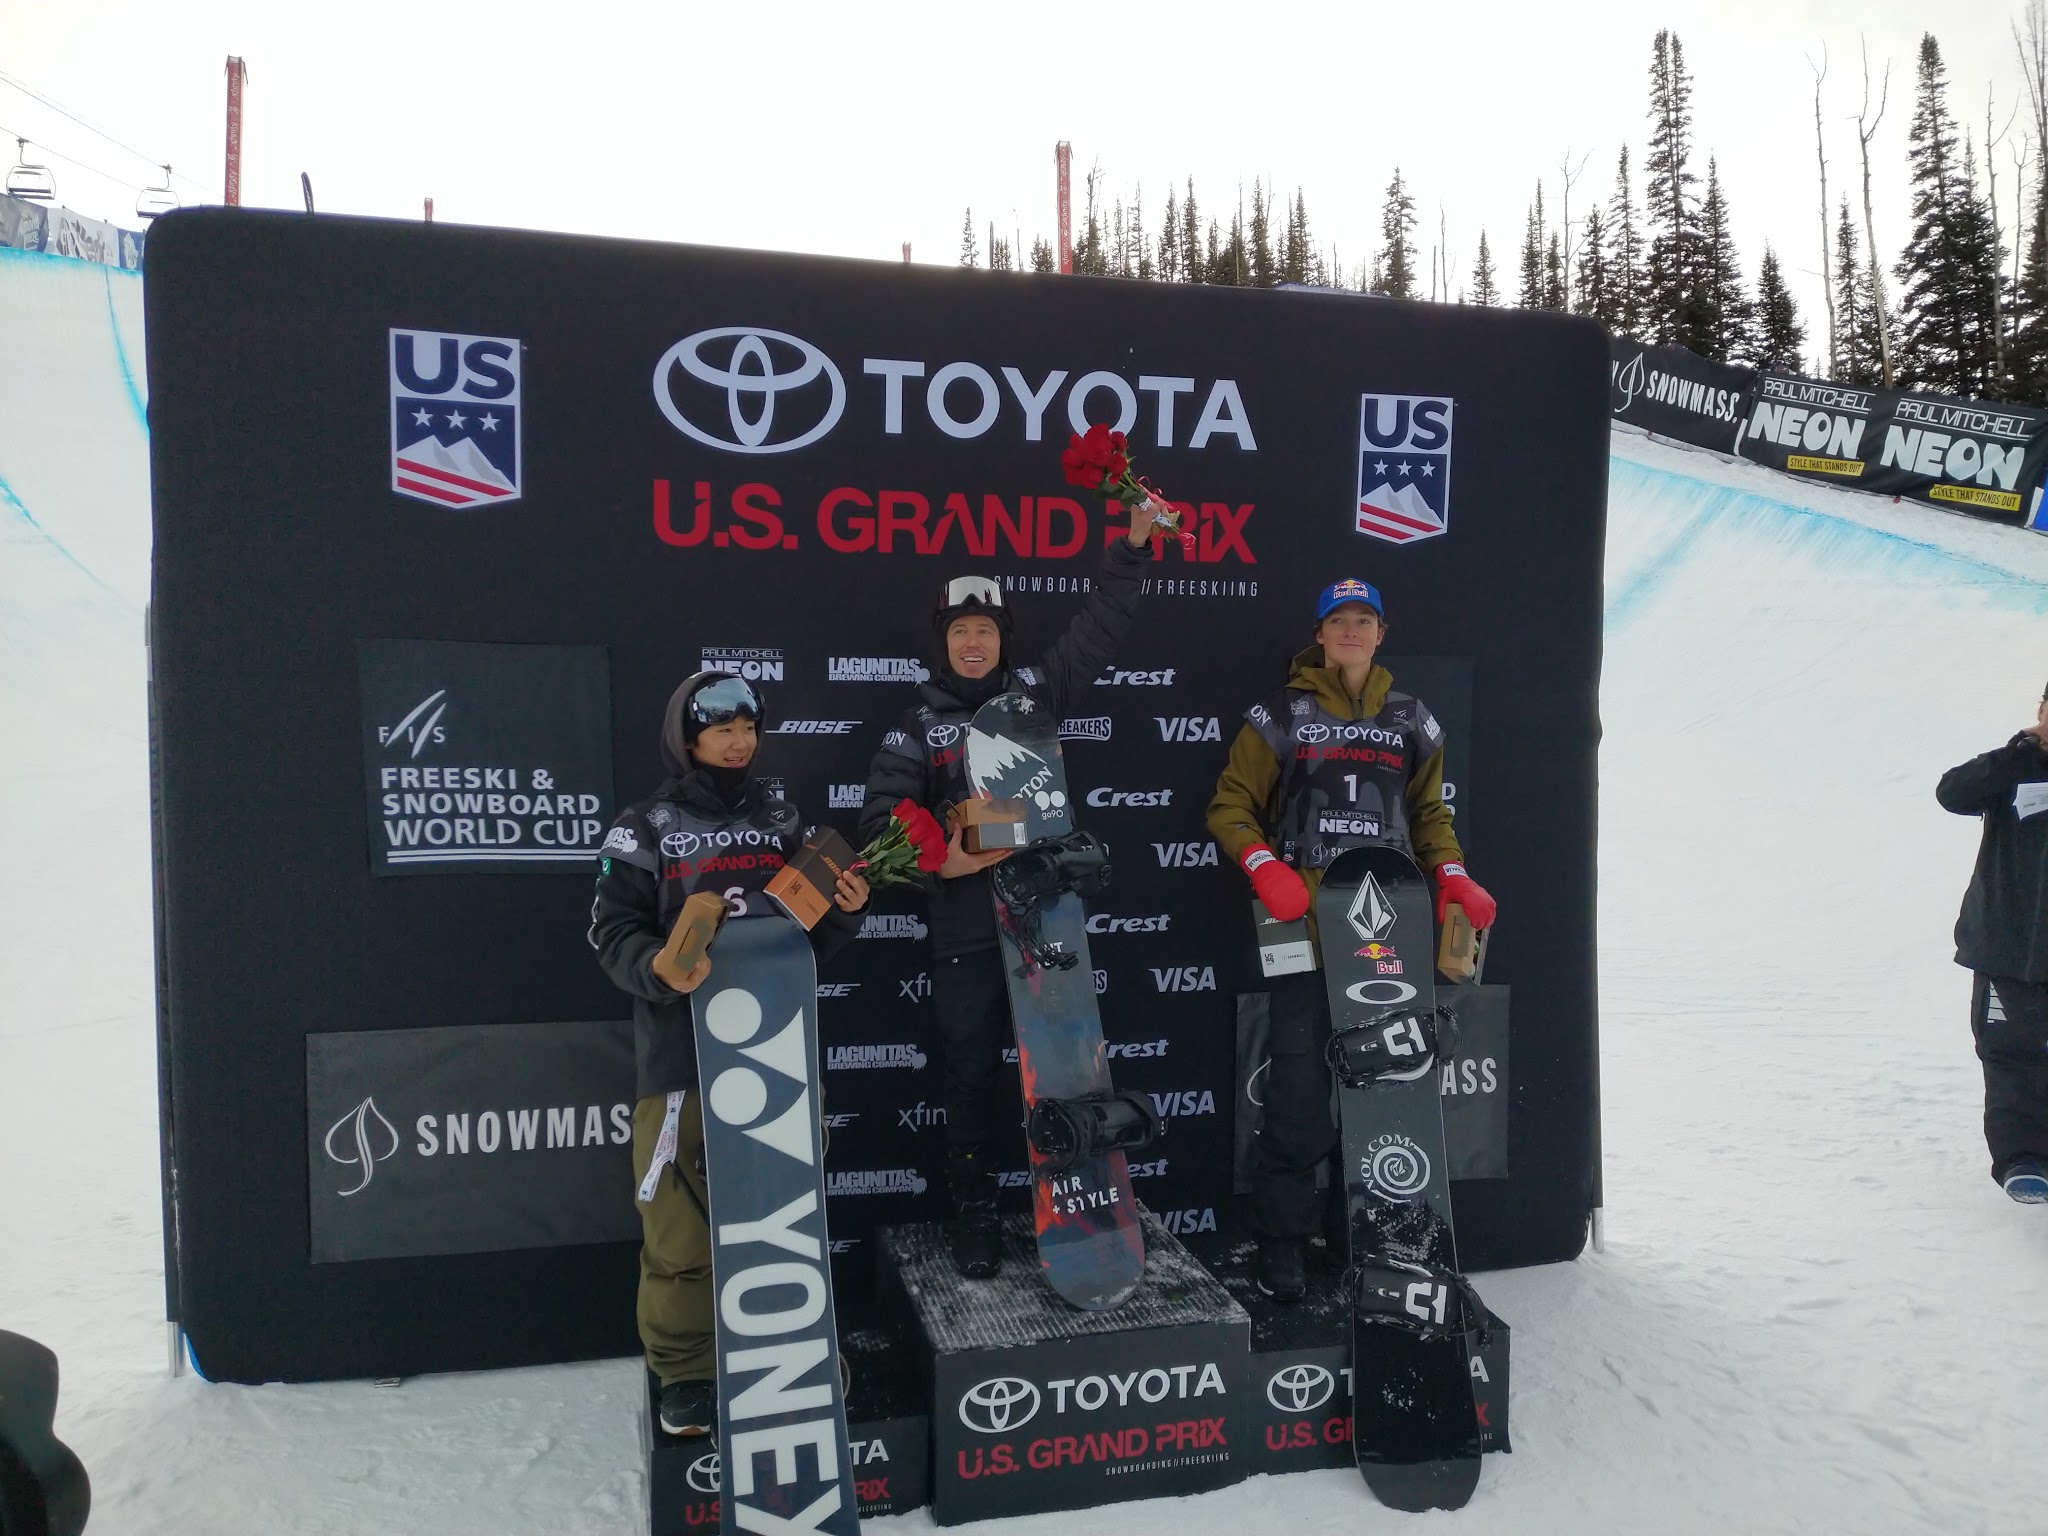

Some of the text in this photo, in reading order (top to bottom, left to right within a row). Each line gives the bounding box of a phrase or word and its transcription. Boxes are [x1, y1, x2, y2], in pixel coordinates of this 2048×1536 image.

[395, 334, 515, 400] US
[863, 358, 1258, 451] TOYOTA
[1764, 379, 1870, 411] PAUL MITCHELL
[1363, 398, 1449, 451] US
[1896, 401, 2031, 437] PAUL MITCHELL
[1748, 402, 1866, 459] NEON
[1790, 457, 1862, 473] STYLE THAT STANDS OUT
[1880, 424, 2025, 491] NEON
[1932, 486, 2018, 507] STYLE THAT STANDS OUT
[653, 480, 798, 550] U.S.
[816, 487, 1088, 559] GRAND
[994, 575, 1092, 594] SNOWBOAR
[1333, 589, 1369, 599] Red Bull
[702, 648, 783, 658] PAUL MITCHELL
[701, 660, 784, 681] NEON
[828, 657, 920, 674] LAGUNITAS
[828, 673, 873, 681] BREWING
[765, 720, 863, 734] BOSE
[1058, 717, 1110, 739] REAKERS
[1153, 717, 1222, 742] VISA
[1332, 726, 1404, 748] TOYOTA
[1322, 747, 1376, 762] GRAND
[1378, 750, 1403, 768] PRIX
[381, 767, 554, 790] FREESKI &
[1012, 765, 1053, 799] TON
[1344, 774, 1357, 802] 1
[382, 793, 600, 815] SNOWBOARD
[1086, 787, 1173, 808] Crest
[1041, 809, 1064, 820] go90
[1342, 811, 1378, 820] MITCHELL
[384, 818, 522, 846] WORLD
[533, 819, 602, 845] CUP
[1319, 818, 1379, 836] NEON
[701, 830, 783, 851] TOYOTA
[697, 855, 757, 873] GRAND
[1150, 842, 1218, 867] VISA
[860, 914, 918, 931] UNITAS
[1085, 913, 1171, 934] Crest
[1377, 960, 1403, 974] Bull
[816, 983, 862, 997] SE
[1148, 966, 1217, 993] VISA
[827, 1043, 918, 1063] LAGUNITAS
[1100, 1039, 1169, 1058] rest
[827, 1061, 871, 1070] BREWING
[1148, 1090, 1216, 1117] VISA
[898, 1101, 947, 1132] xfin
[416, 1103, 633, 1157] SNOWMAS
[1127, 1158, 1169, 1178] est
[1360, 1133, 1412, 1191] VOLCOM
[827, 1168, 918, 1188] LAGUNITAS
[1052, 1176, 1083, 1197] AIR
[827, 1186, 872, 1196] BREWING
[1067, 1187, 1120, 1214] STYLE
[1047, 1363, 1227, 1413] TOYOTA
[1265, 1417, 1318, 1451] U.S.
[957, 1417, 1229, 1480] U.S. GRAND PRIX
[854, 1476, 891, 1501] RIX
[685, 1500, 721, 1526] U.S
